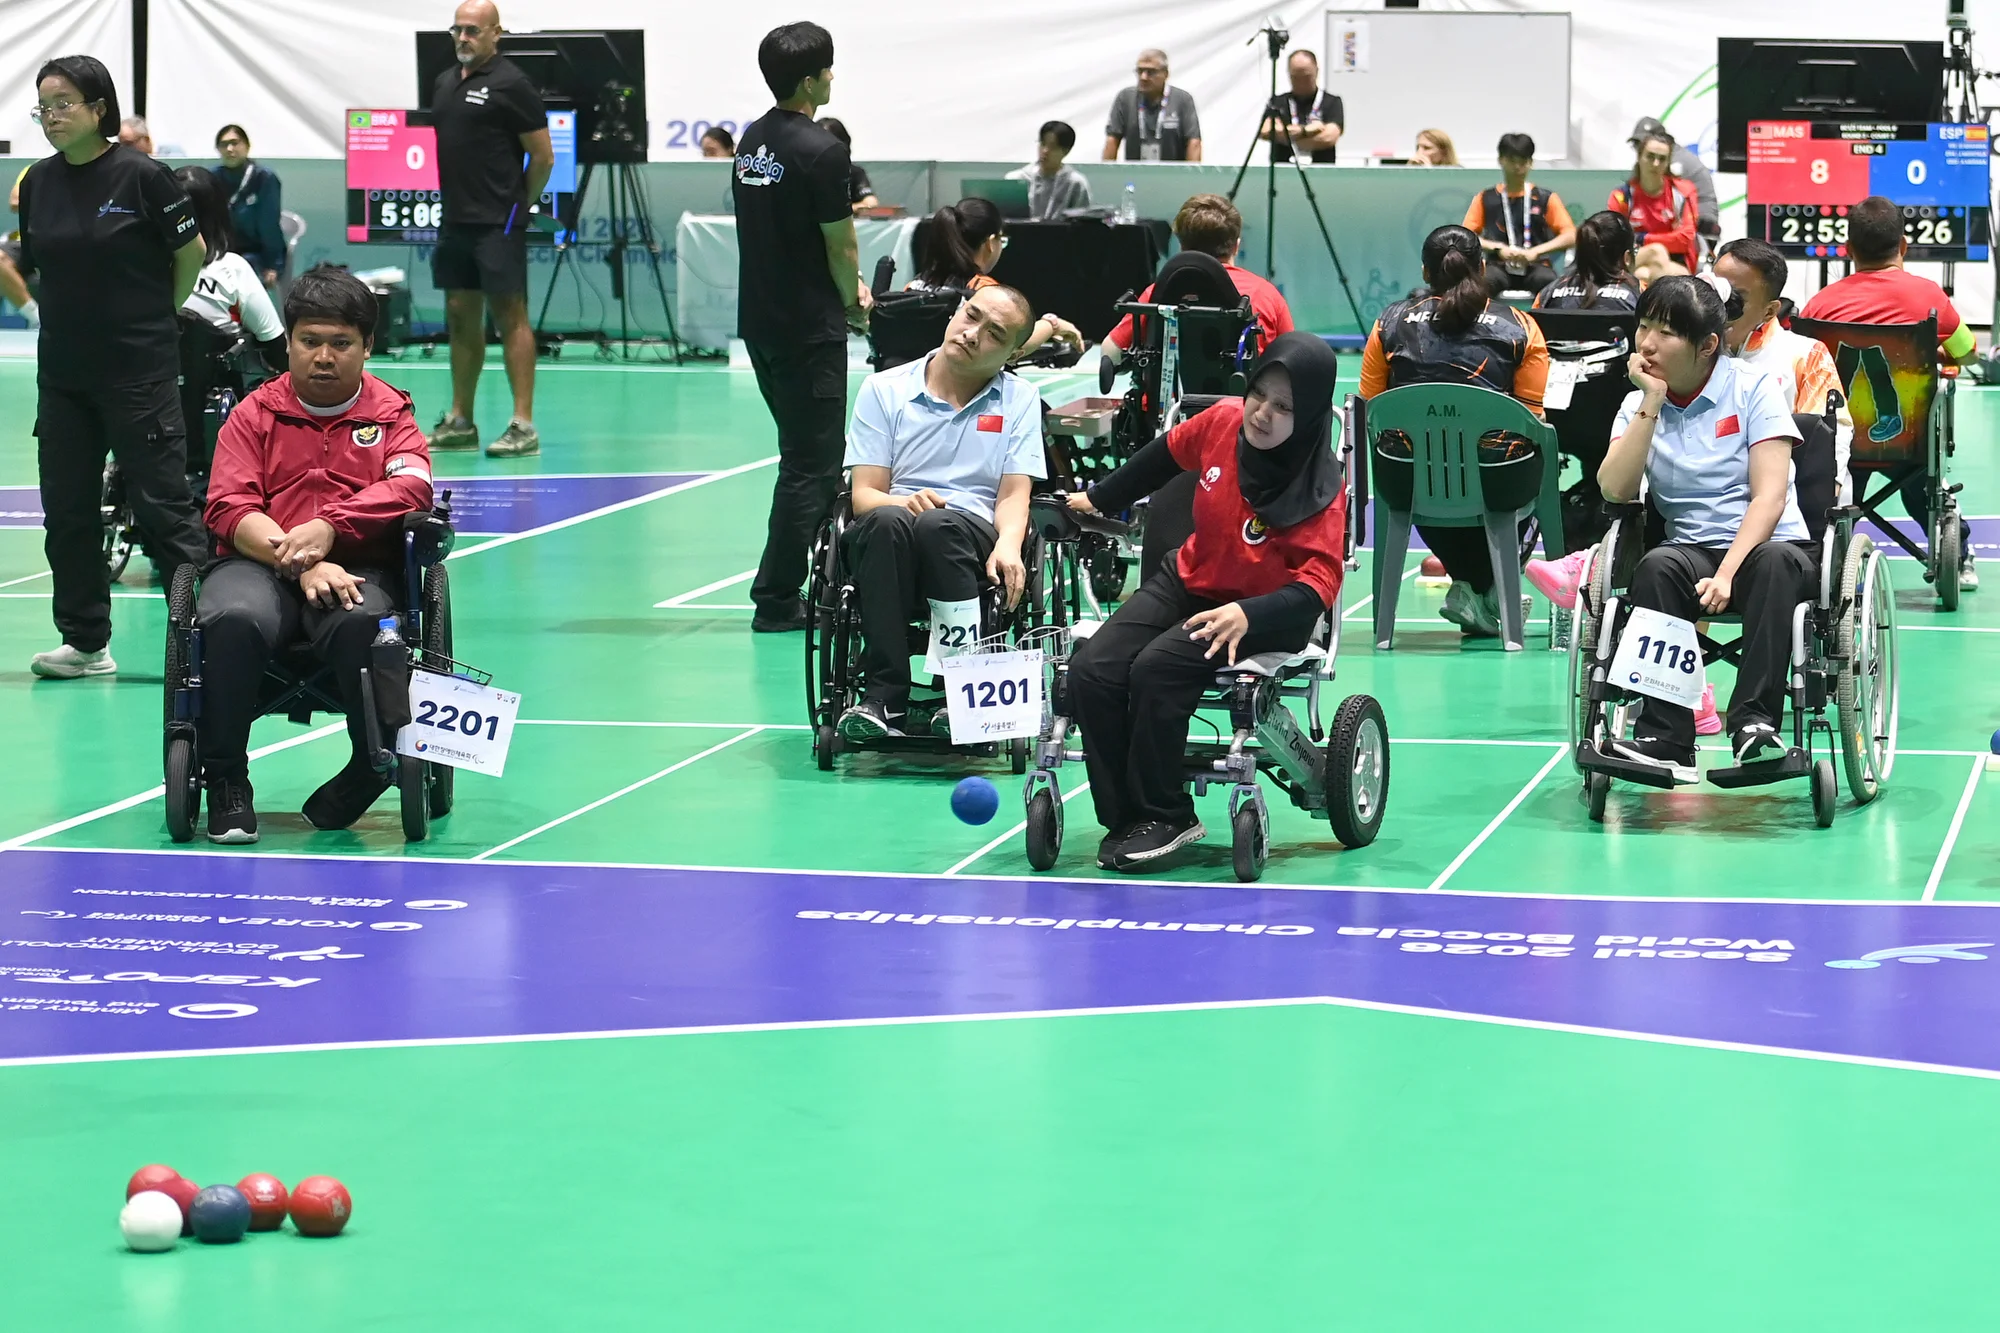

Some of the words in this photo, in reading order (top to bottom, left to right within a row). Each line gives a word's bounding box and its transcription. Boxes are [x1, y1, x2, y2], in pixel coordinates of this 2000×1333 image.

[371, 113, 398, 127] BRA
[1773, 126, 1804, 139] MAS
[1939, 127, 1964, 140] ESP
[1853, 144, 1874, 155] END
[1874, 144, 1884, 154] 4
[405, 145, 426, 170] 0
[1810, 159, 1830, 184] 8
[1907, 160, 1927, 185] 0
[1781, 219, 1849, 243] 2:53
[1905, 220, 1952, 244] :26
[1426, 404, 1462, 417] A.M.
[1638, 635, 1697, 675] 1118
[961, 678, 1029, 709] 1201
[415, 700, 500, 741] 2201
[217, 916, 363, 928] KOREA
[795, 909, 1315, 935] Championships
[1336, 926, 1575, 944] Boccia
[1594, 935, 1796, 950] World
[0, 939, 167, 952] METROPOLI
[80, 937, 280, 950] GOVERNMENT
[177, 947, 270, 955] SEOUL
[1400, 942, 1576, 957] 2026
[1593, 948, 1793, 962] Seoul
[43, 1006, 148, 1015] Ministry
